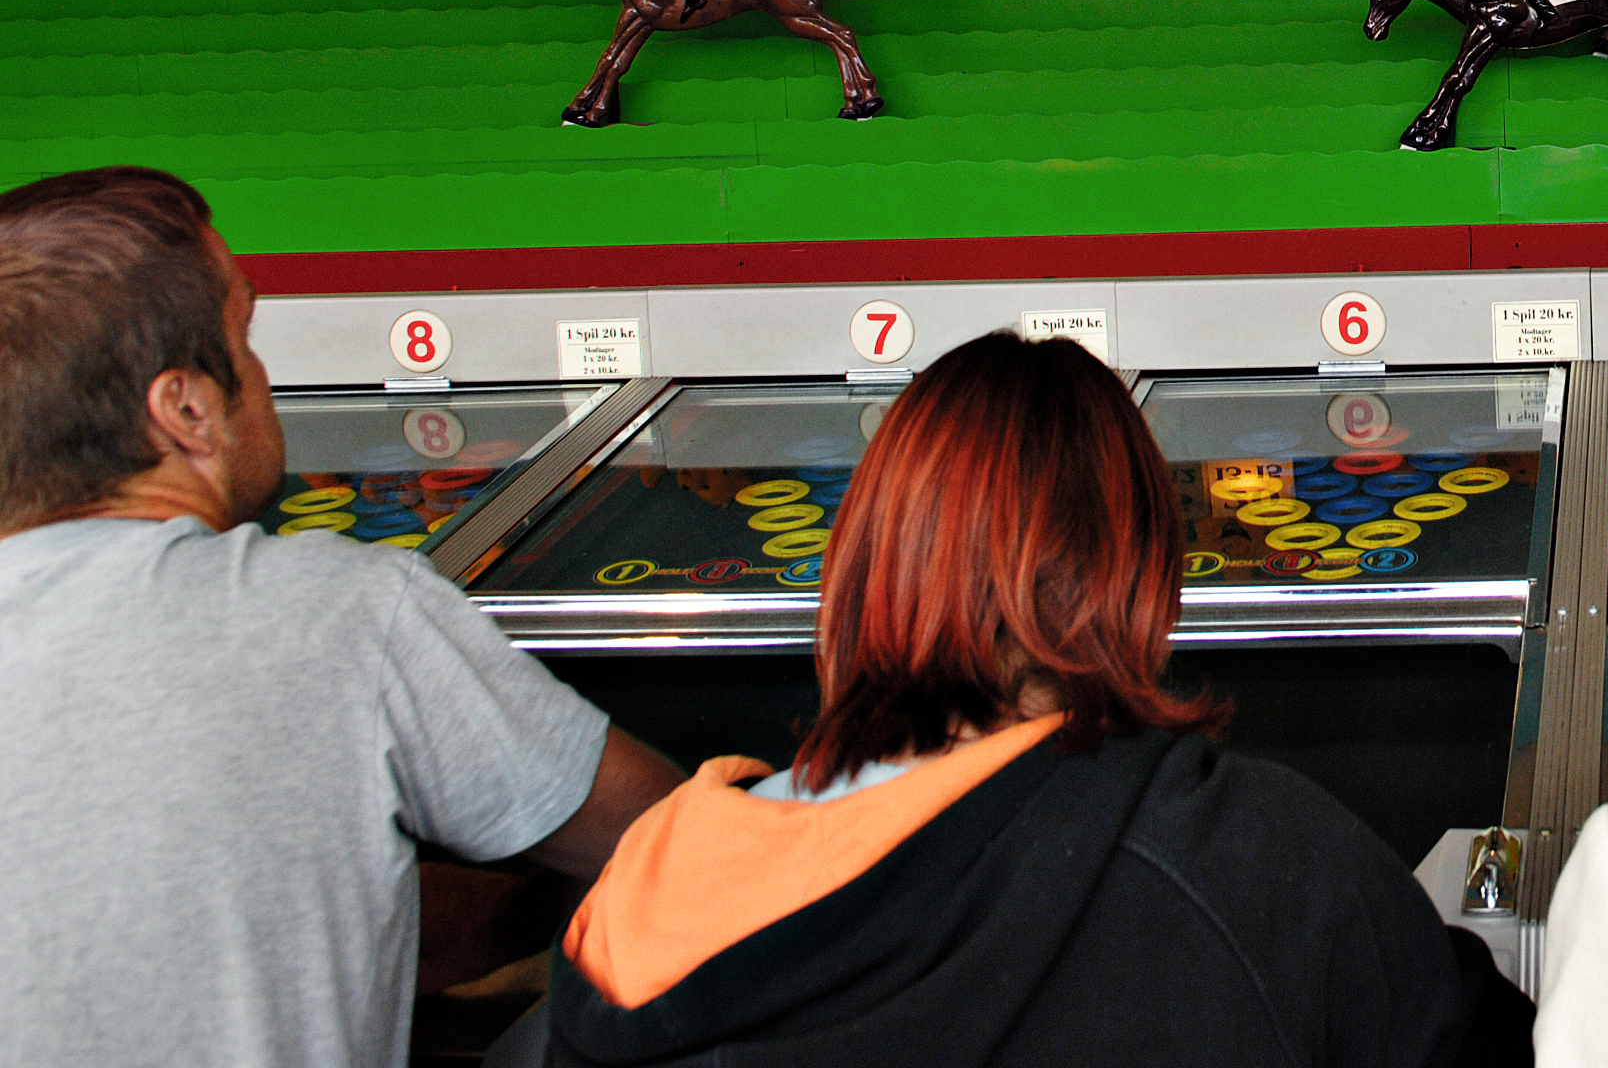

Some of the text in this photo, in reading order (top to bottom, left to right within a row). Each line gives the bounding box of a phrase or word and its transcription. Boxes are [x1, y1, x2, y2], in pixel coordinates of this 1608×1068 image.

[1339, 301, 1369, 345] 6
[1512, 309, 1536, 323] Spil
[1539, 308, 1554, 319] 20
[1558, 308, 1573, 319] kr.
[1042, 318, 1065, 333] Spil
[1068, 318, 1083, 328] 20
[1087, 317, 1102, 328] kr.
[407, 320, 436, 363] 8
[576, 327, 598, 342] Spil
[602, 328, 617, 338] 20
[620, 327, 636, 338] kr.
[867, 313, 897, 355] 7
[1190, 556, 1206, 572] 1
[1379, 552, 1396, 567] 2
[615, 564, 636, 580] 1
